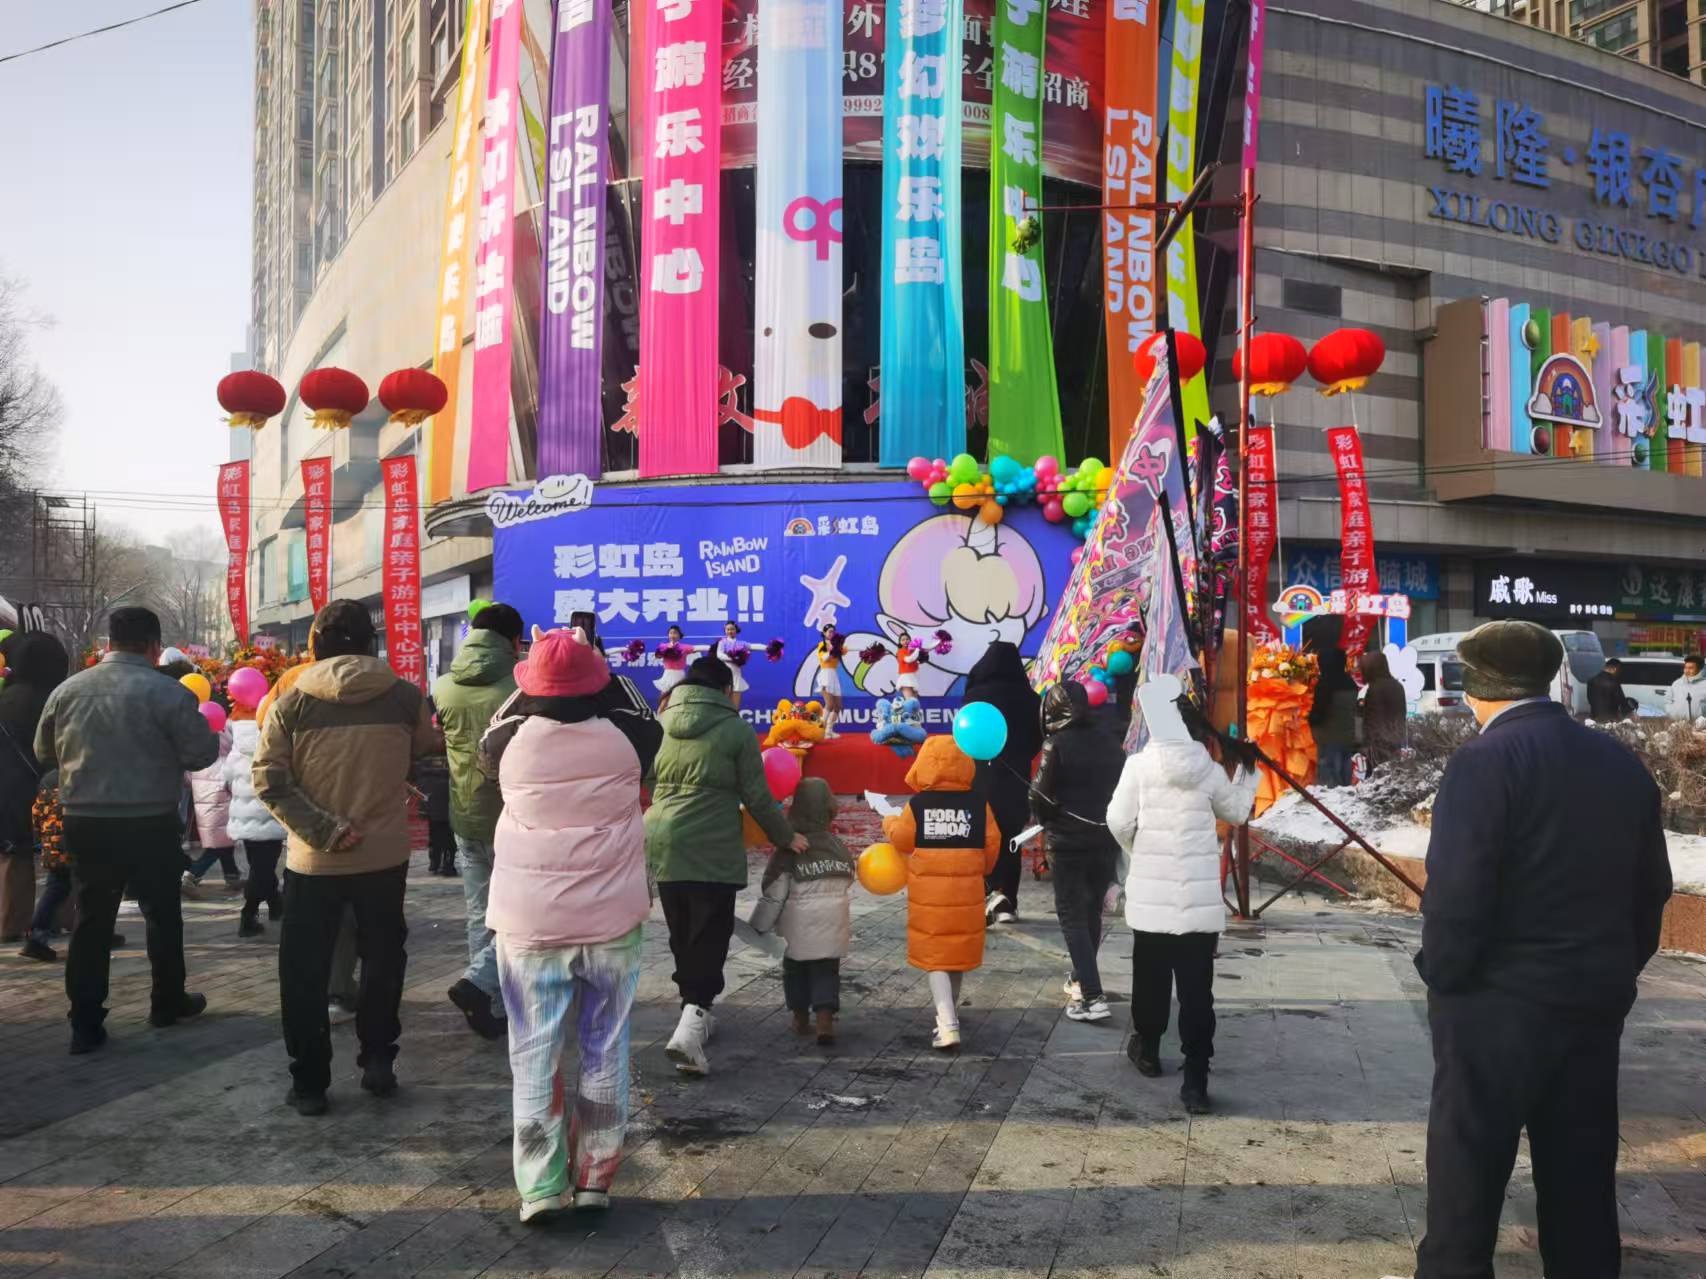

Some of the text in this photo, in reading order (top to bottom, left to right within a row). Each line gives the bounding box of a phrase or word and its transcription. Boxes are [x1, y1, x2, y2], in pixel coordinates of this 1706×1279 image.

[1428, 188, 1562, 243] XILONG
[818, 515, 879, 536] 彩虹岛
[554, 542, 684, 579] 彩虹岛
[1293, 556, 1428, 593] 众信脑城
